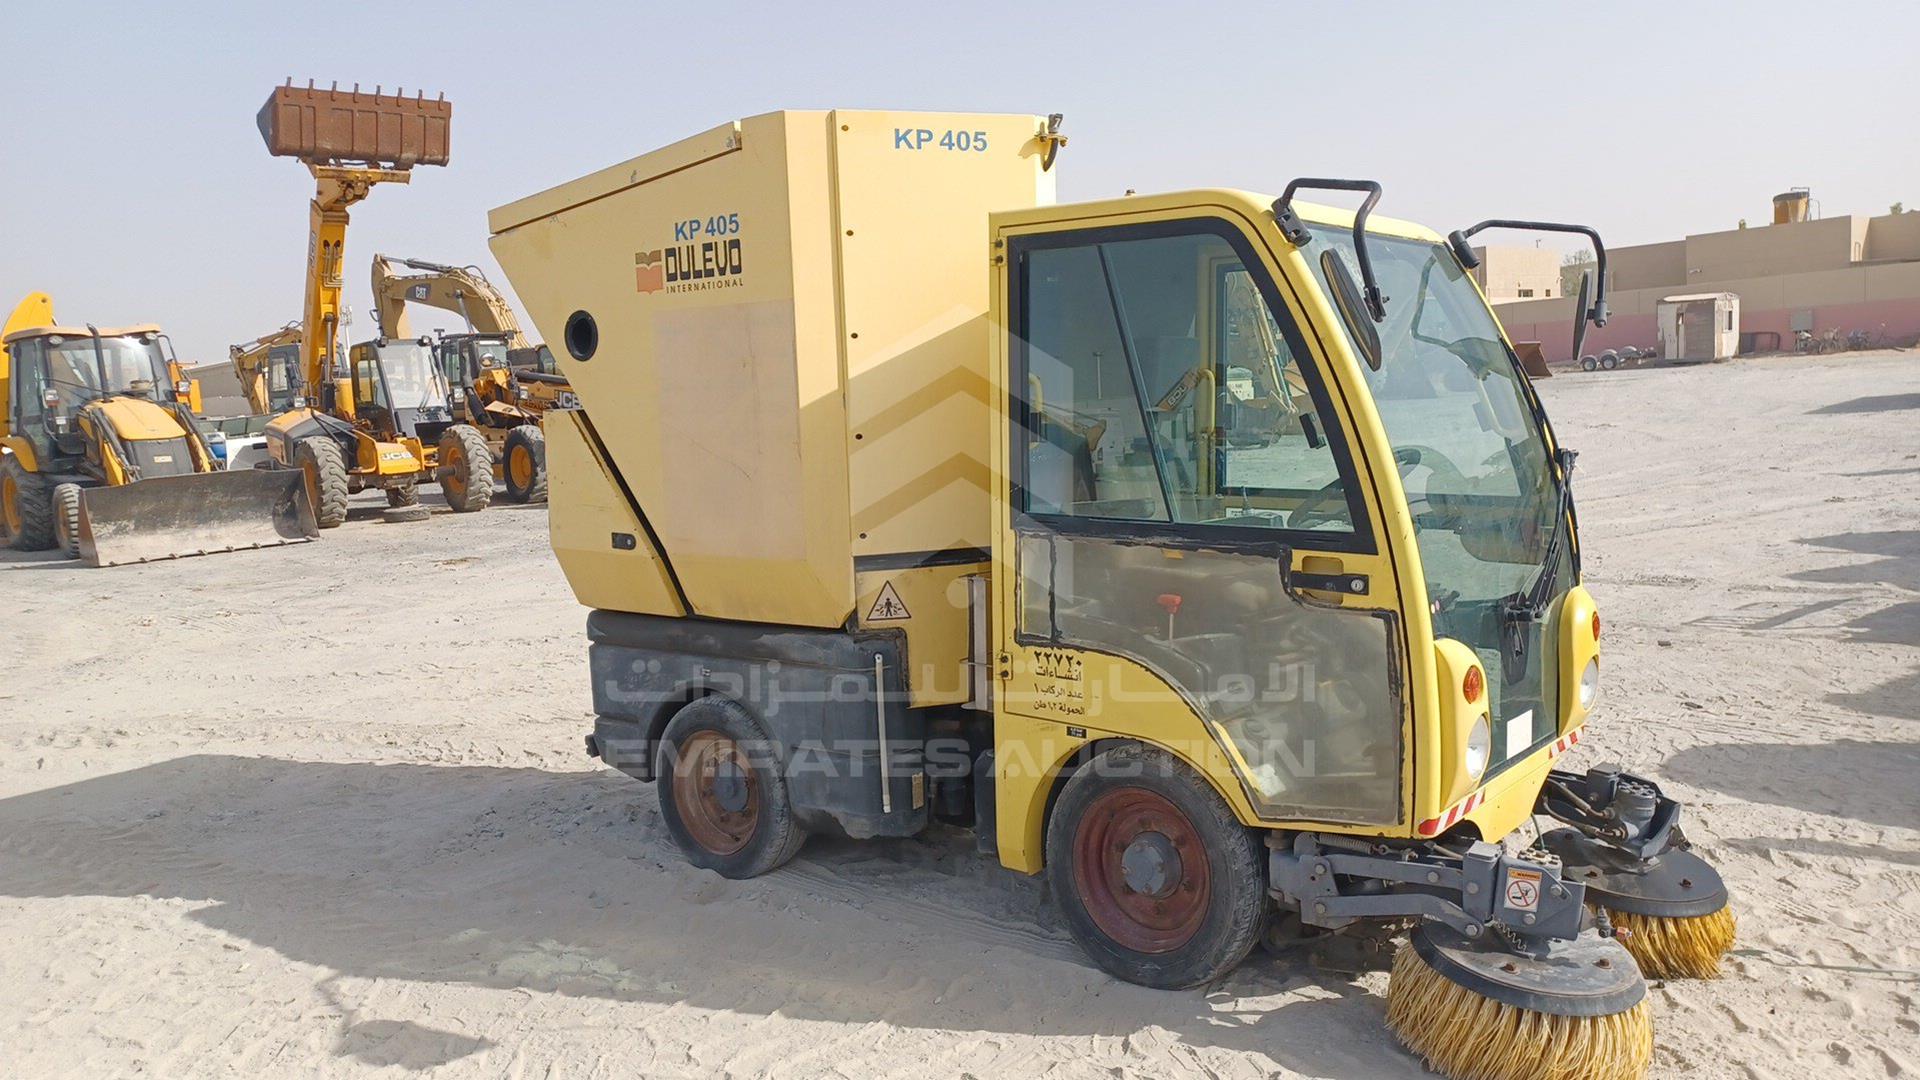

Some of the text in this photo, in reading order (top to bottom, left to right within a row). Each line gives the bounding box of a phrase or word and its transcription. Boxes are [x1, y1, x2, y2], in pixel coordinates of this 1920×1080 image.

[894, 128, 988, 152] KP 405
[674, 213, 740, 241] KP 405
[665, 239, 742, 282] DULEVO
[666, 278, 744, 294] INTERNATIONAL
[381, 452, 413, 461] JCB
